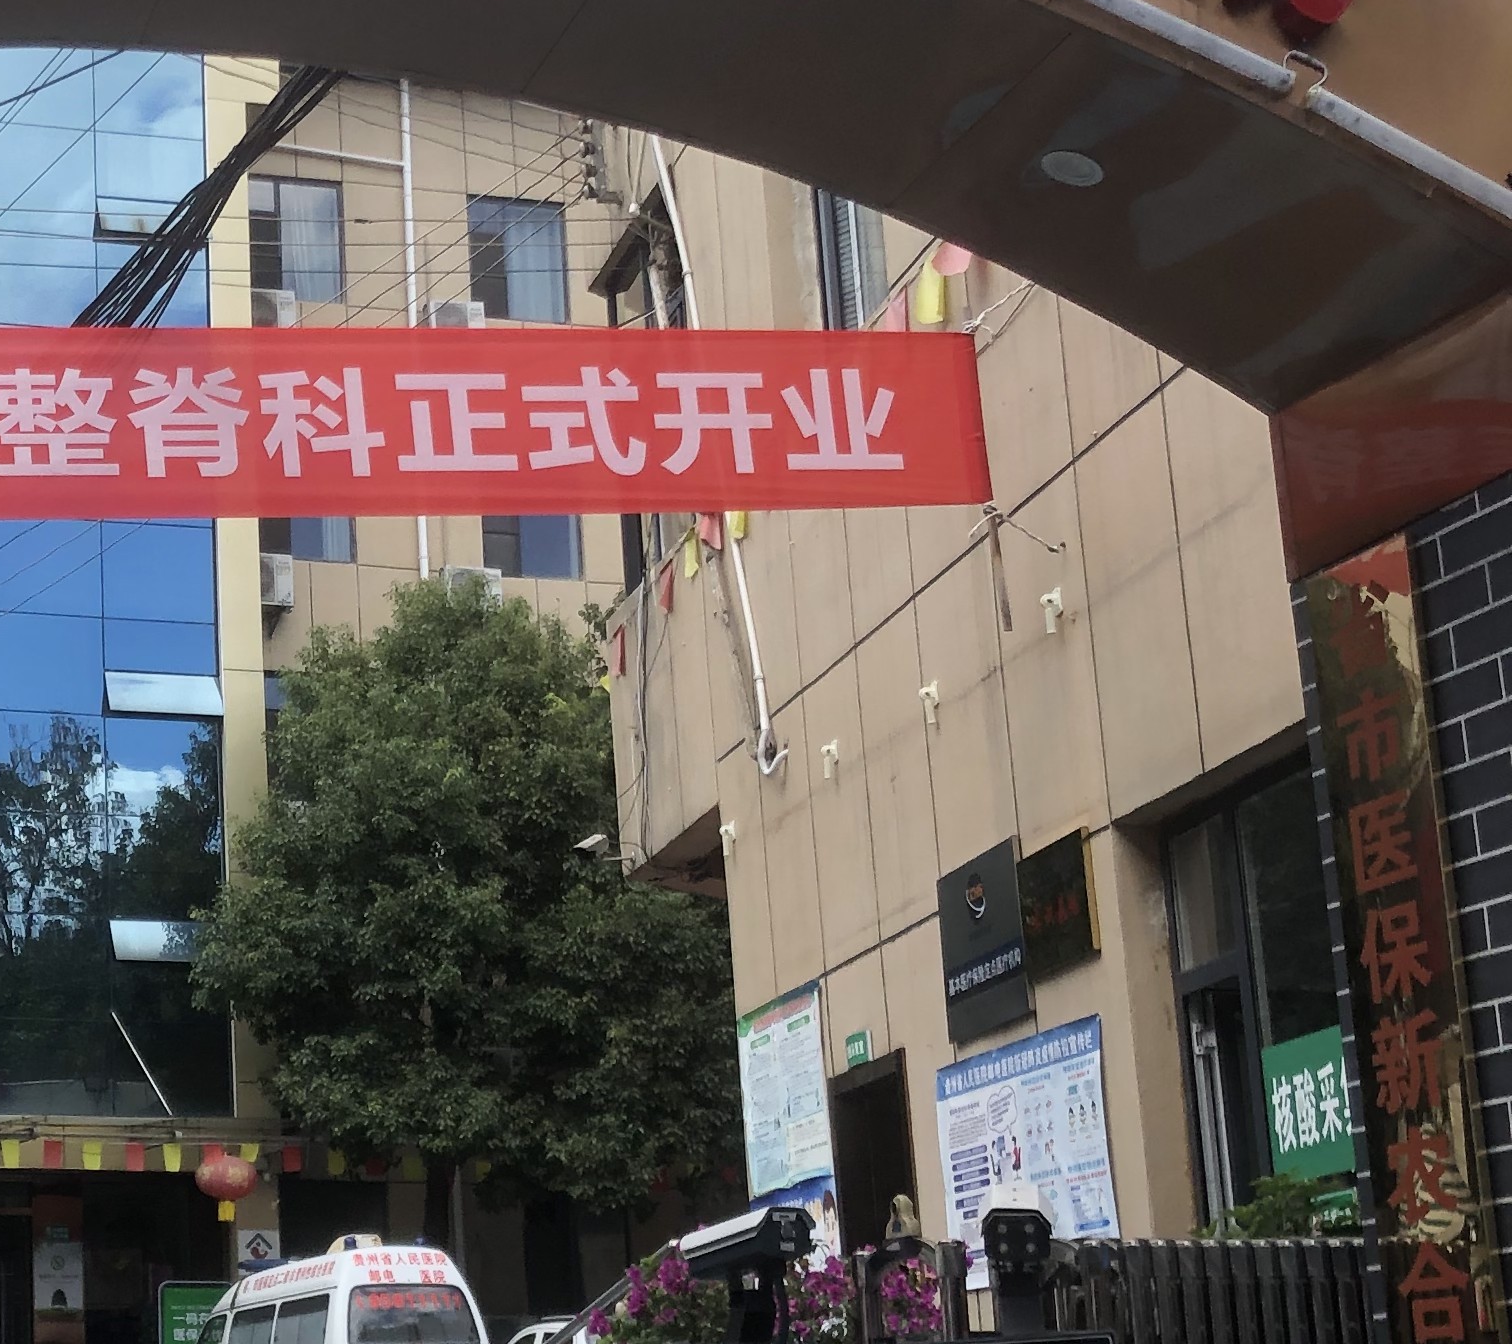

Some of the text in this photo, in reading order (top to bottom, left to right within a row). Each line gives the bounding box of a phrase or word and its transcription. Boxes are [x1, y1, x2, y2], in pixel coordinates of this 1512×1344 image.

[352, 1253, 448, 1267] 贵州省人民医院
[368, 1269, 447, 1283] 邮电 医院
